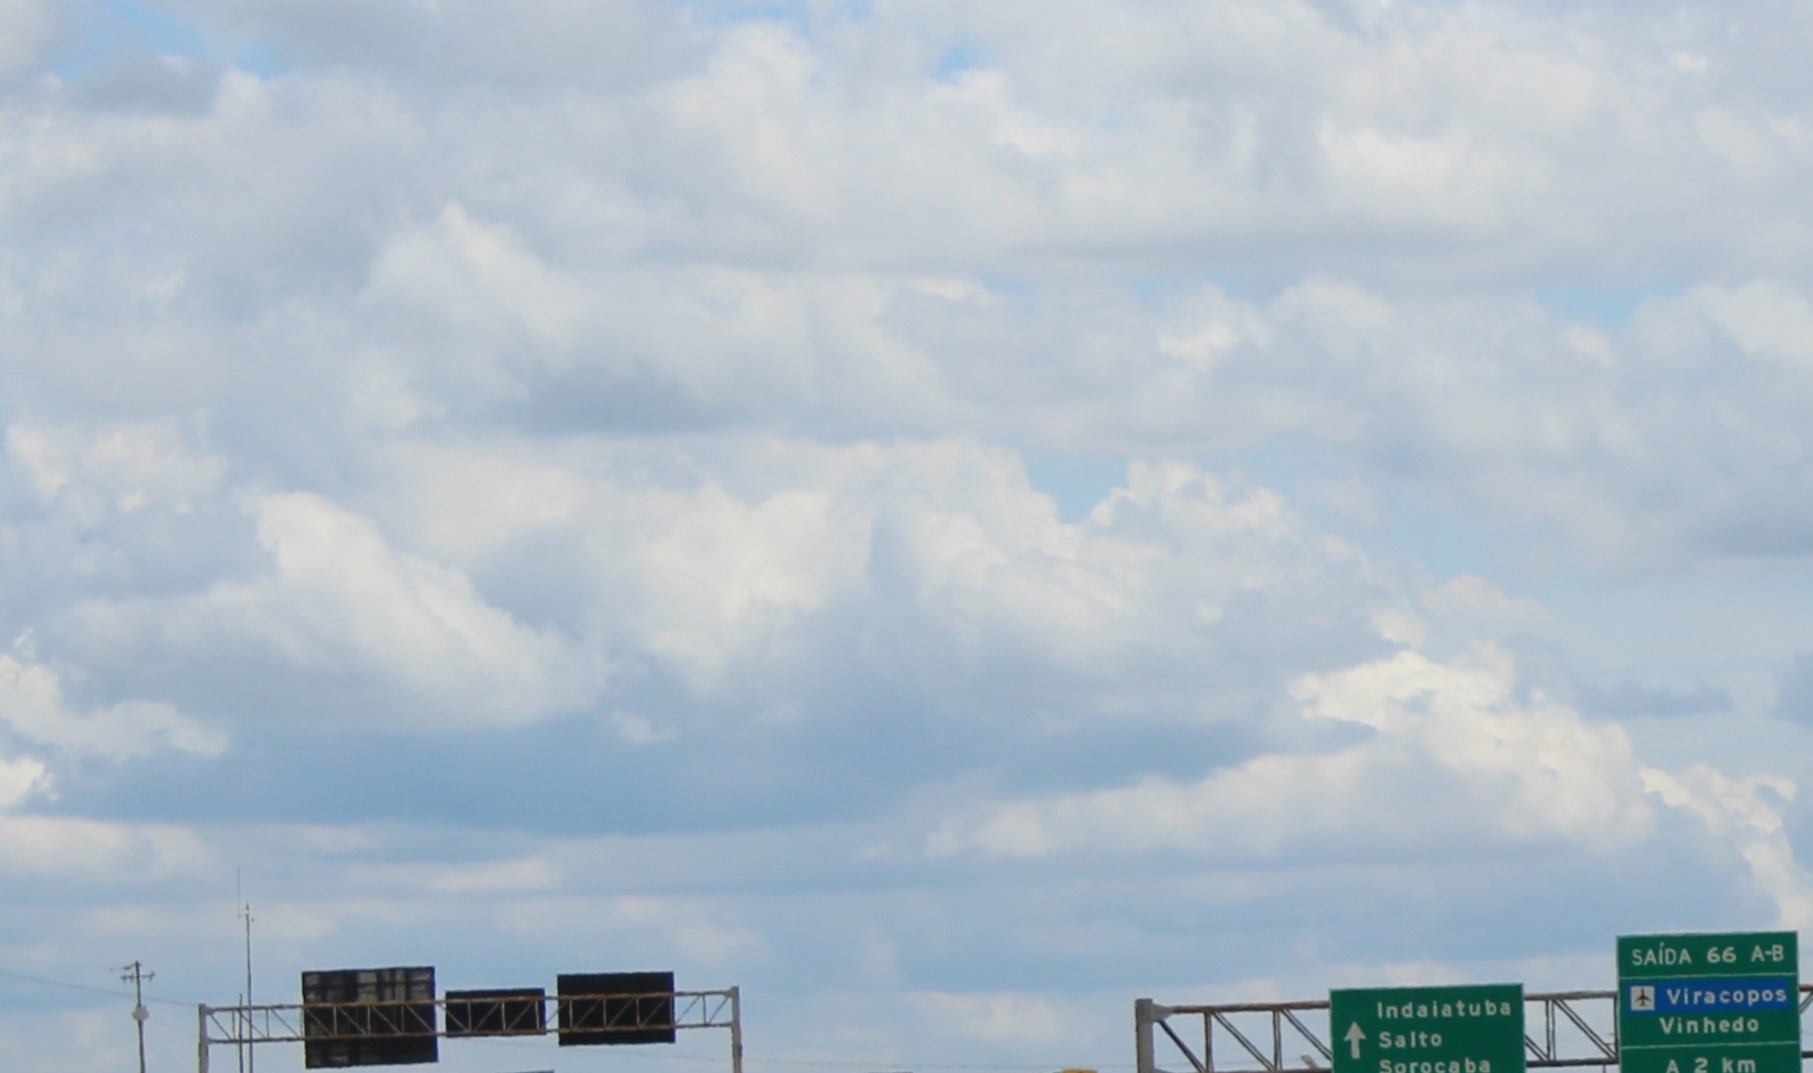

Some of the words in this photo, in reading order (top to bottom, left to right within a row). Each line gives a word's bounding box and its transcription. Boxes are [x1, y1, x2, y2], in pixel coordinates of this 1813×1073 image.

[1631, 942, 1692, 966] SAÍDA
[1706, 946, 1737, 964] 66
[1750, 944, 1785, 963] A-B
[1666, 987, 1788, 1006] Viracopos
[1377, 999, 1512, 1020] Indaiatuba
[1658, 1016, 1760, 1035] Vinhedo
[1378, 1031, 1443, 1049] Salto
[1722, 1057, 1757, 1073] km
